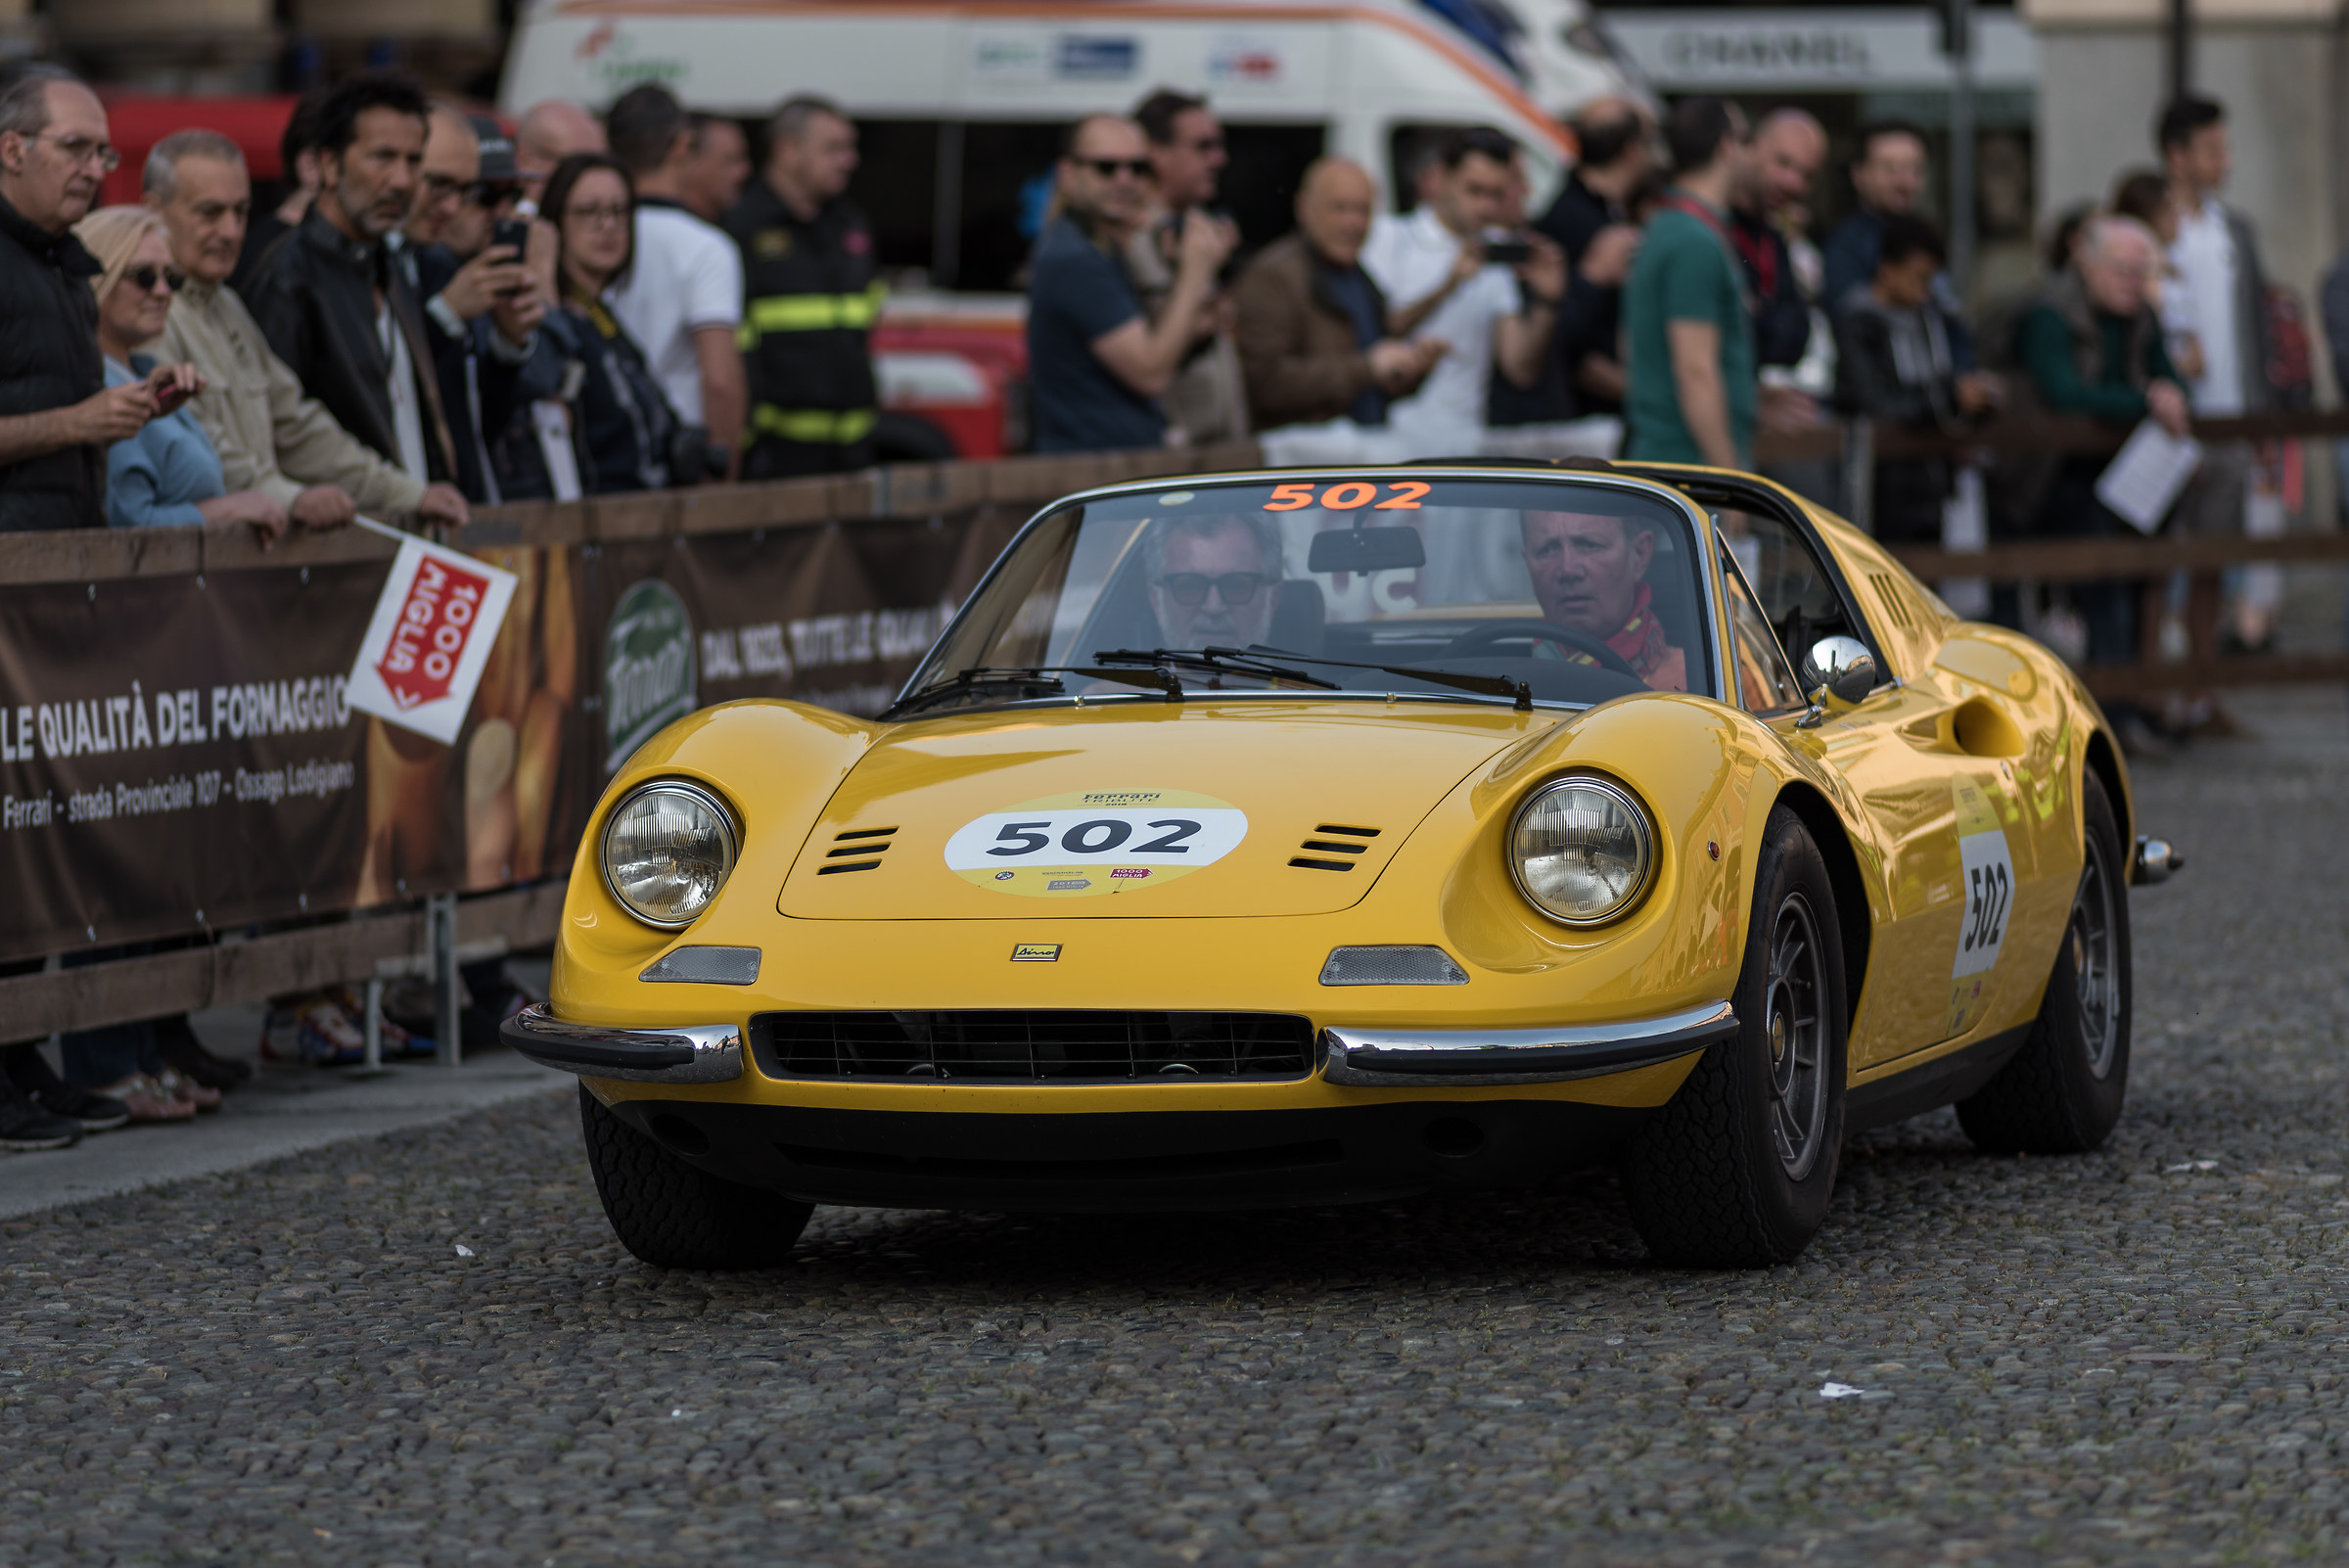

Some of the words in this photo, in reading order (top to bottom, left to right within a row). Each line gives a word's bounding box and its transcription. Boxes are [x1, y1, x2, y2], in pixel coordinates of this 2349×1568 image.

[1263, 482, 1431, 511] 502
[387, 562, 447, 673] MIGLIA
[424, 584, 480, 681] 1000
[0, 706, 34, 762] LE
[39, 678, 154, 759] QUALITÀ
[156, 688, 207, 747] DEL
[211, 674, 351, 741] FORMAGGIO
[3, 790, 53, 831] Ferrari
[69, 783, 113, 824] strada
[116, 774, 194, 817] Provinciale
[196, 769, 222, 807] 107
[986, 819, 1202, 855] 502
[1964, 861, 2008, 952] 502
[1016, 946, 1055, 956] Dino
